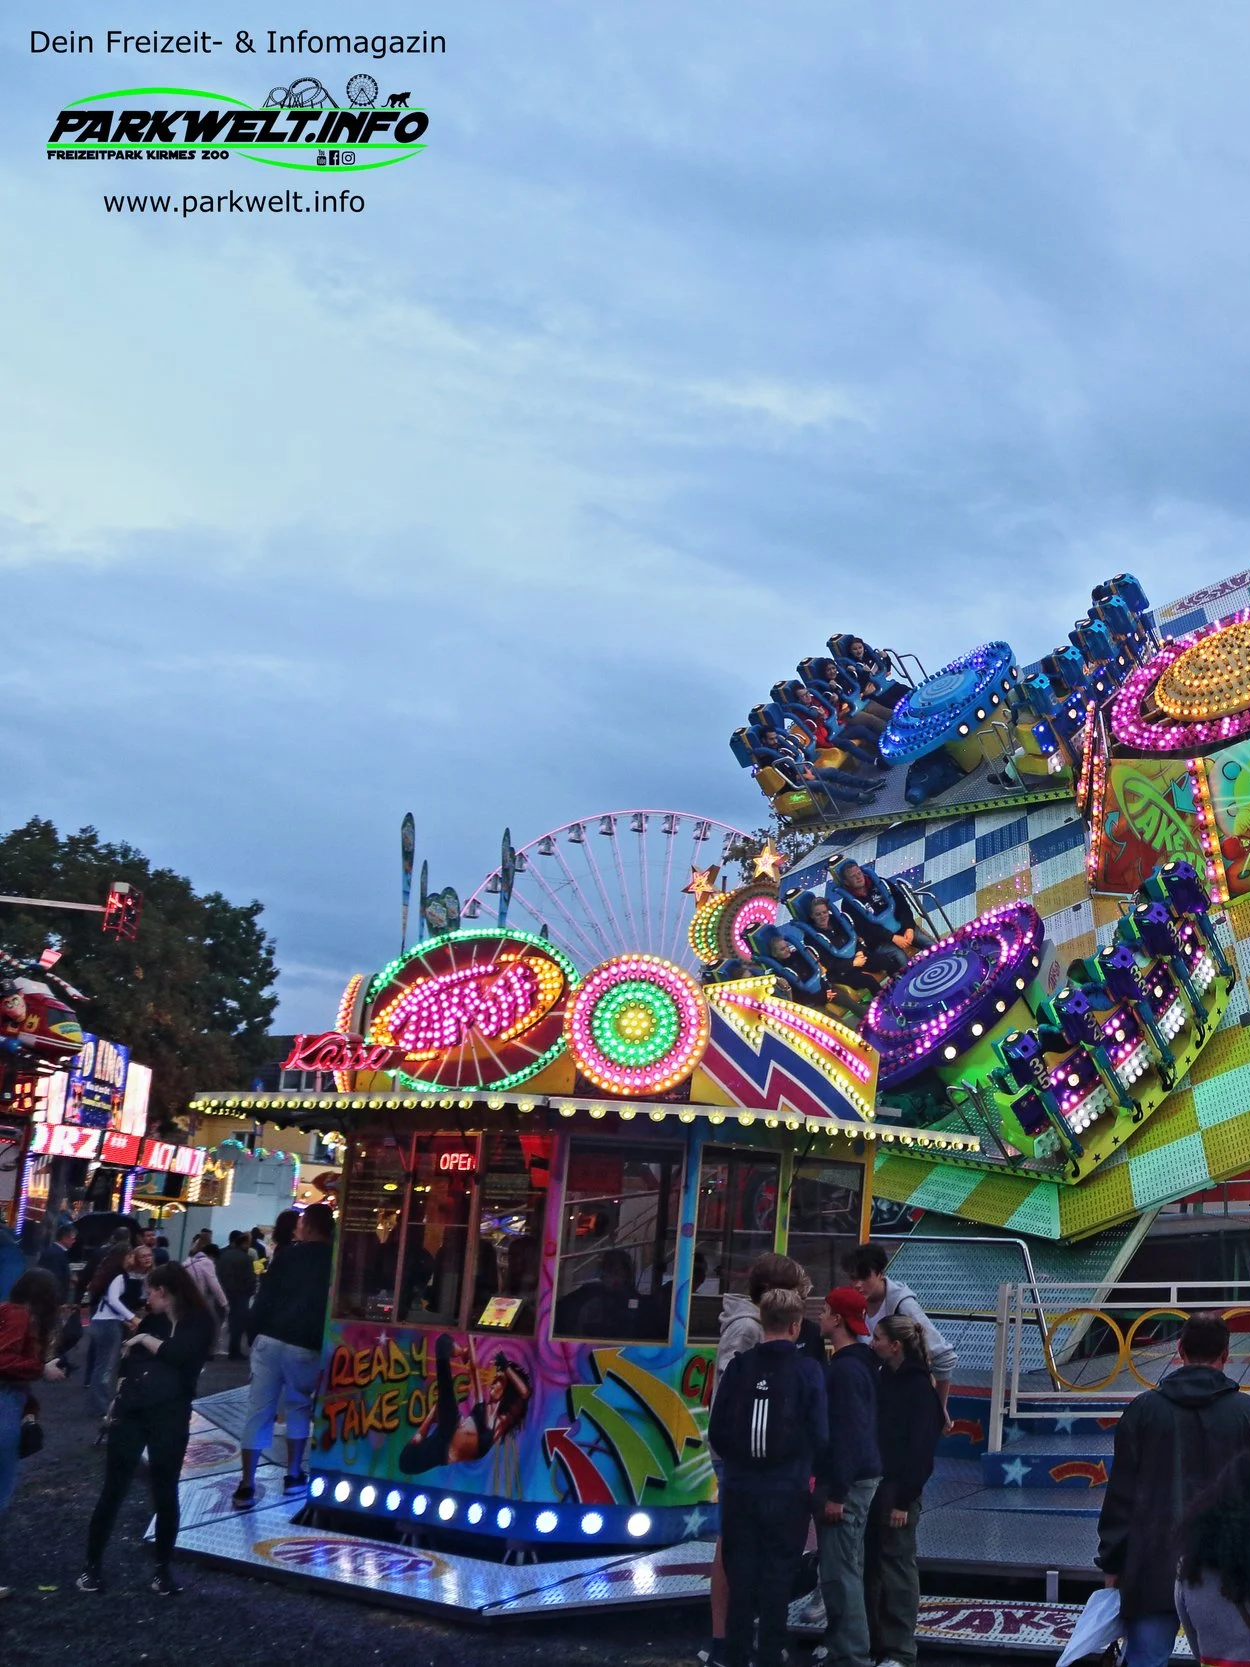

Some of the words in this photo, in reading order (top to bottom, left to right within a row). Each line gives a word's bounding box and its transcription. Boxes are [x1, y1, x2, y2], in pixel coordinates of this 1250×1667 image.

[1166, 920, 1185, 952] 32
[1130, 965, 1150, 996] 33
[1083, 1011, 1106, 1041] 34
[1029, 1058, 1052, 1090] 35
[330, 1336, 428, 1389] READY
